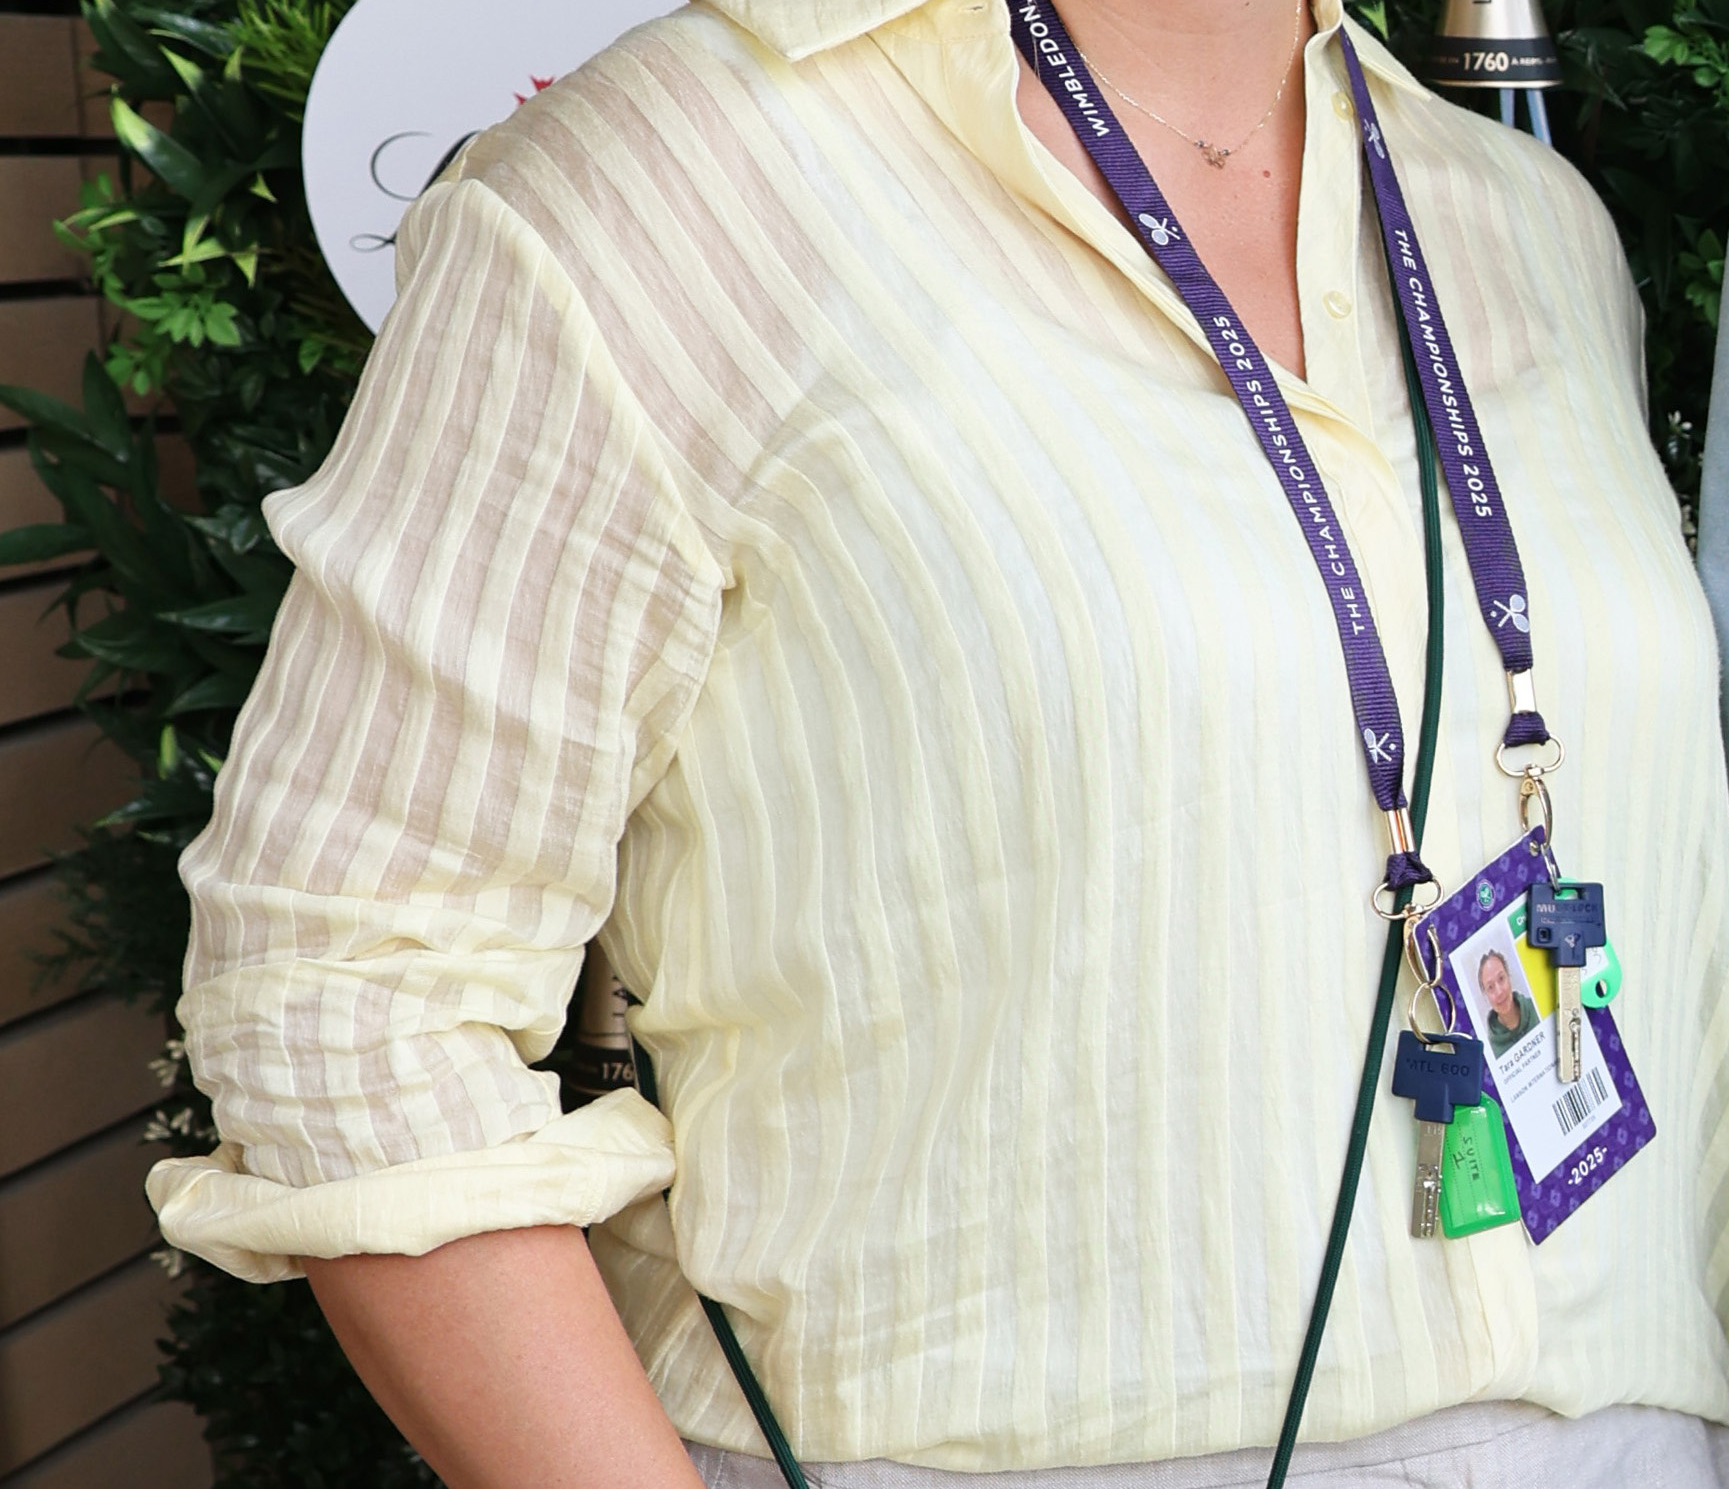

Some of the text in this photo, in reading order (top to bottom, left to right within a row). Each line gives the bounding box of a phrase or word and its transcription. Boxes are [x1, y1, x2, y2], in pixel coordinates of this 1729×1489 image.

[1463, 51, 1509, 72] 1760
[1395, 228, 1493, 518] THE CHAMPIONSHIPS 2025
[1213, 315, 1366, 637] THE CHAMPIONSHIPS 2025
[601, 1062, 636, 1081] 176
